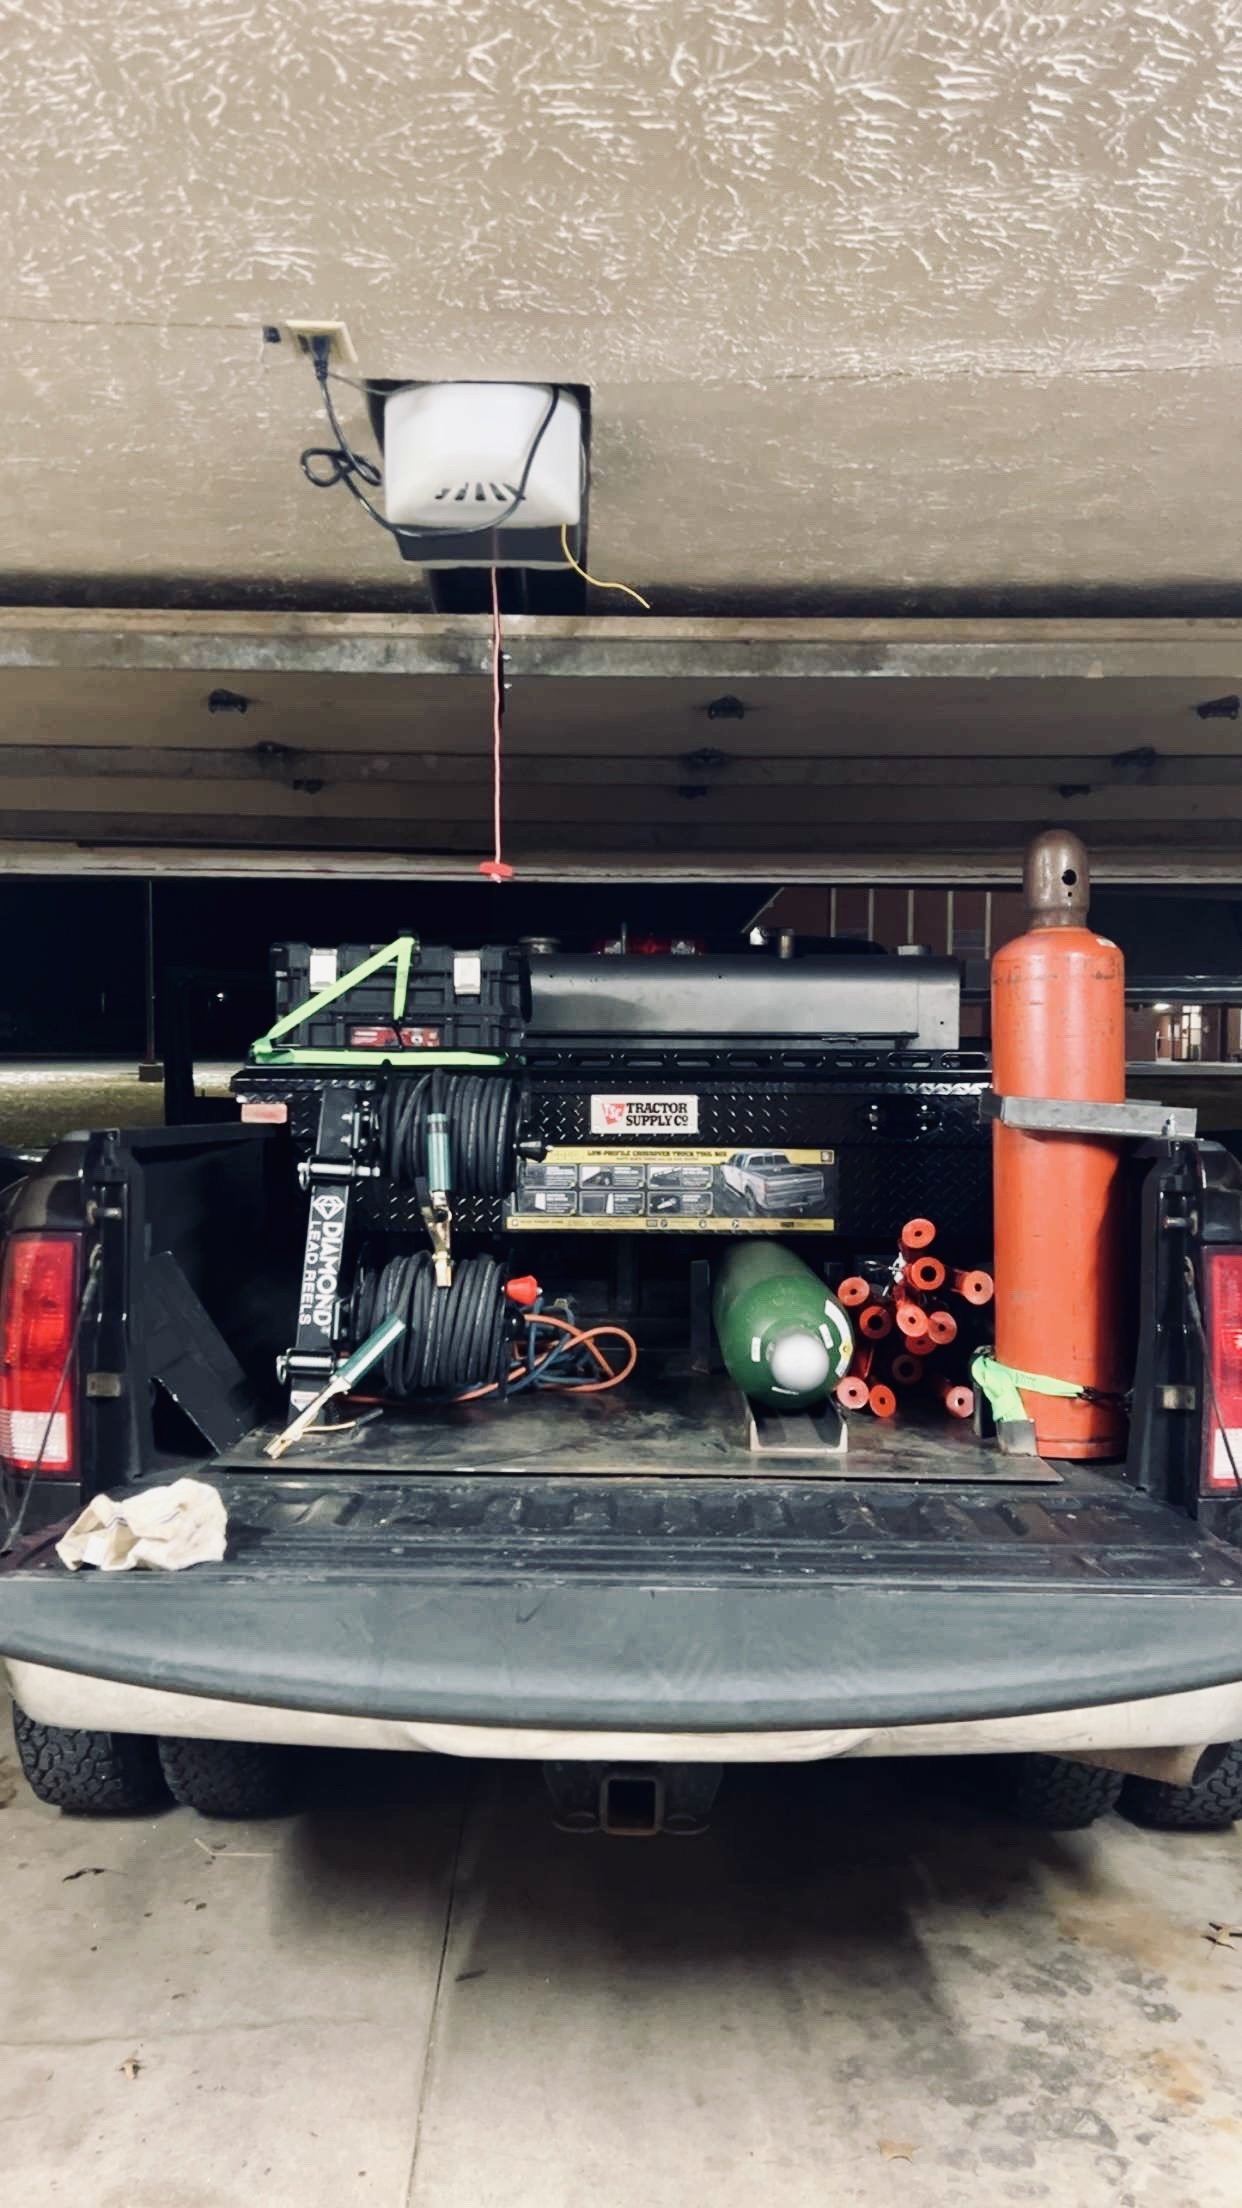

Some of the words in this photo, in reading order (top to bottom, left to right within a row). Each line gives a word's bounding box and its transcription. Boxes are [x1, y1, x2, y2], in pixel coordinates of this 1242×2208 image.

[626, 1103, 688, 1114] TRACTOR
[626, 1115, 672, 1126] SUPPLY
[305, 1221, 322, 1265] LEAD
[313, 1221, 343, 1327] DIAMOND
[299, 1270, 317, 1326] REELS
